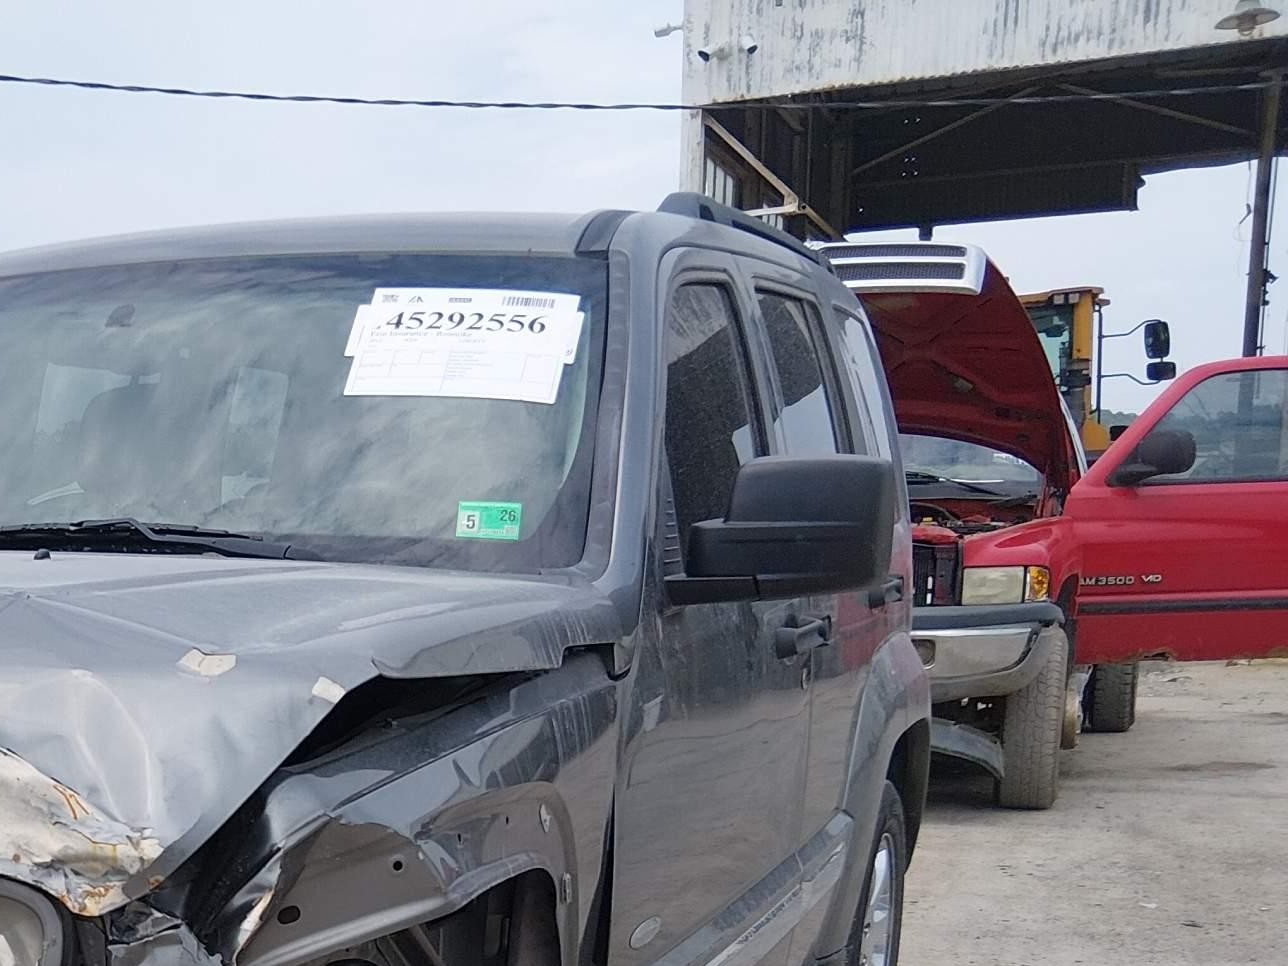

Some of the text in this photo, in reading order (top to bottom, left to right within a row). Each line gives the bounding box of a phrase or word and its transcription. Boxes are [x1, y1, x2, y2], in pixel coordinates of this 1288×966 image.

[466, 514, 476, 529] 5
[500, 509, 516, 522] 26
[1079, 577, 1096, 586] AM
[1098, 576, 1135, 585] 3500
